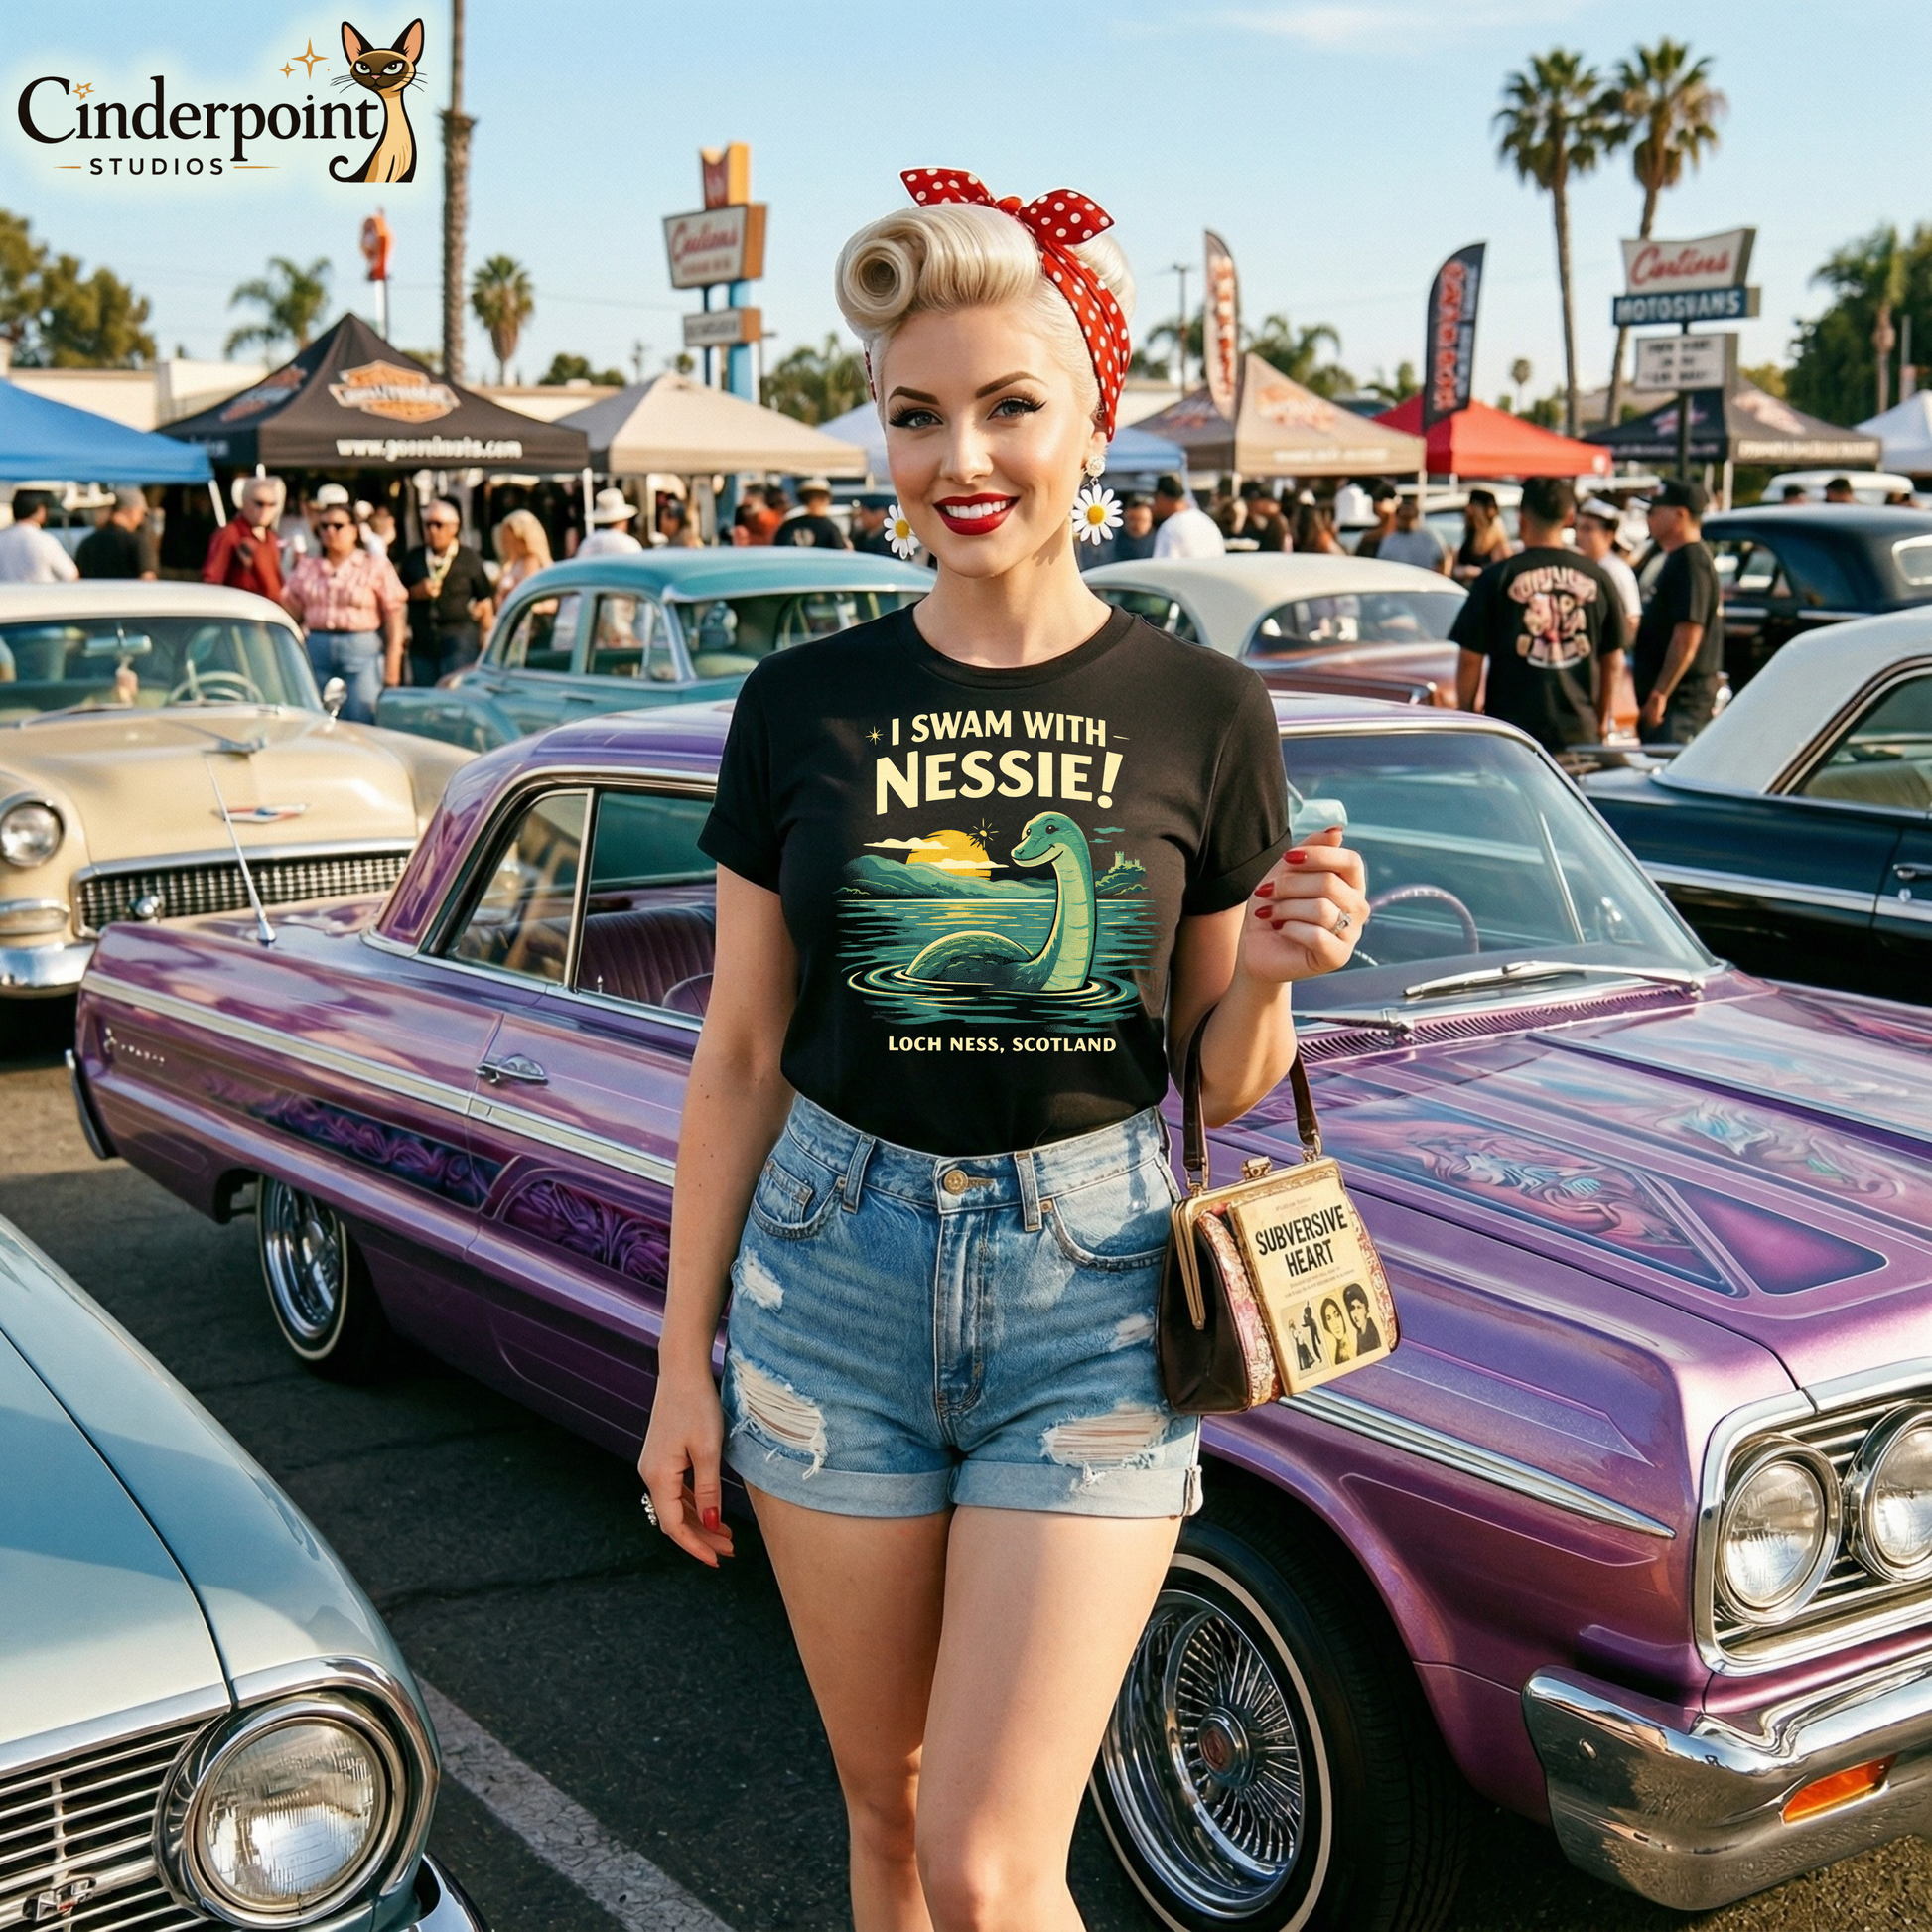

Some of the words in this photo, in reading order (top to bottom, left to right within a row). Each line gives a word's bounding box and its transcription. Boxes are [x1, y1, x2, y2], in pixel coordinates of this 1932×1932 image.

[892, 717, 900, 746] I
[910, 709, 1013, 743] SWAM
[1022, 710, 1107, 748] WITH
[876, 749, 1125, 816] NESSIE!
[889, 1035, 942, 1052] LOCH
[950, 1037, 1006, 1054] NESS,
[1012, 1037, 1117, 1053] SCOTLAND
[1255, 1204, 1348, 1256] SUBVERSIVE
[1285, 1239, 1334, 1277] HEART
